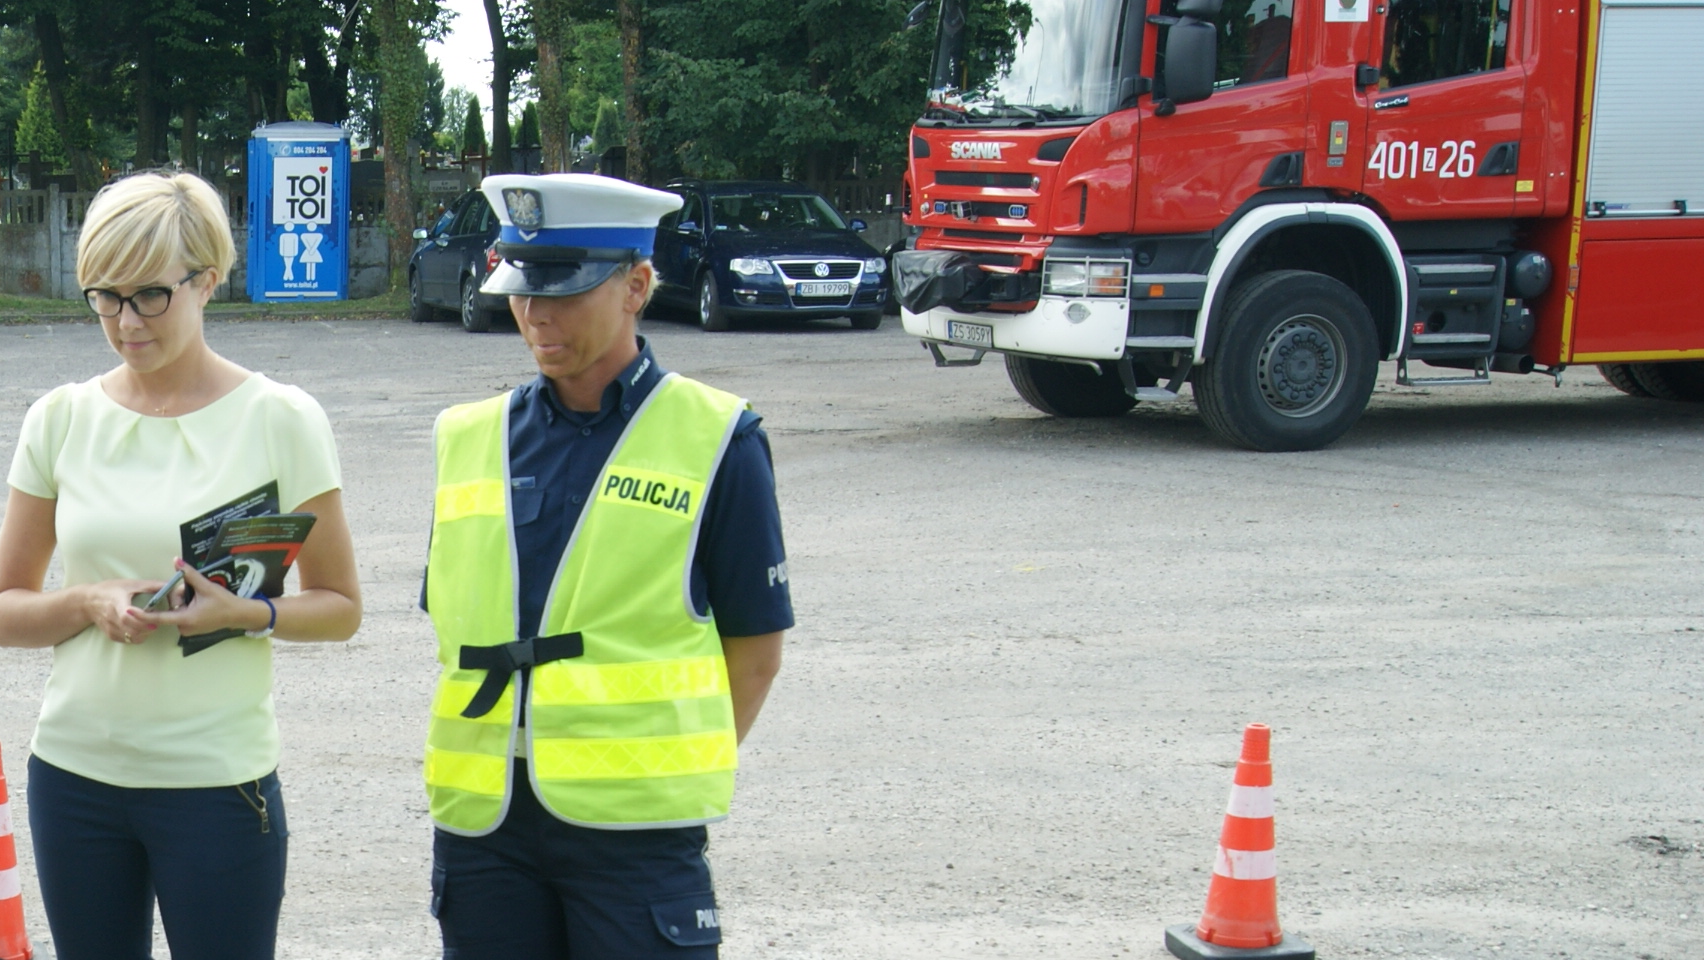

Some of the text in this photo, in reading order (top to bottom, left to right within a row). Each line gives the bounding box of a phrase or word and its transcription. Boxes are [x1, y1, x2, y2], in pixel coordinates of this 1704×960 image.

[951, 141, 1001, 159] SCANIA
[1368, 140, 1476, 179] 401 Z 26
[287, 175, 326, 196] TOI
[286, 198, 325, 219] TOI
[823, 284, 847, 293] 19799
[953, 324, 964, 338] ZS
[604, 475, 690, 514] POLICJA
